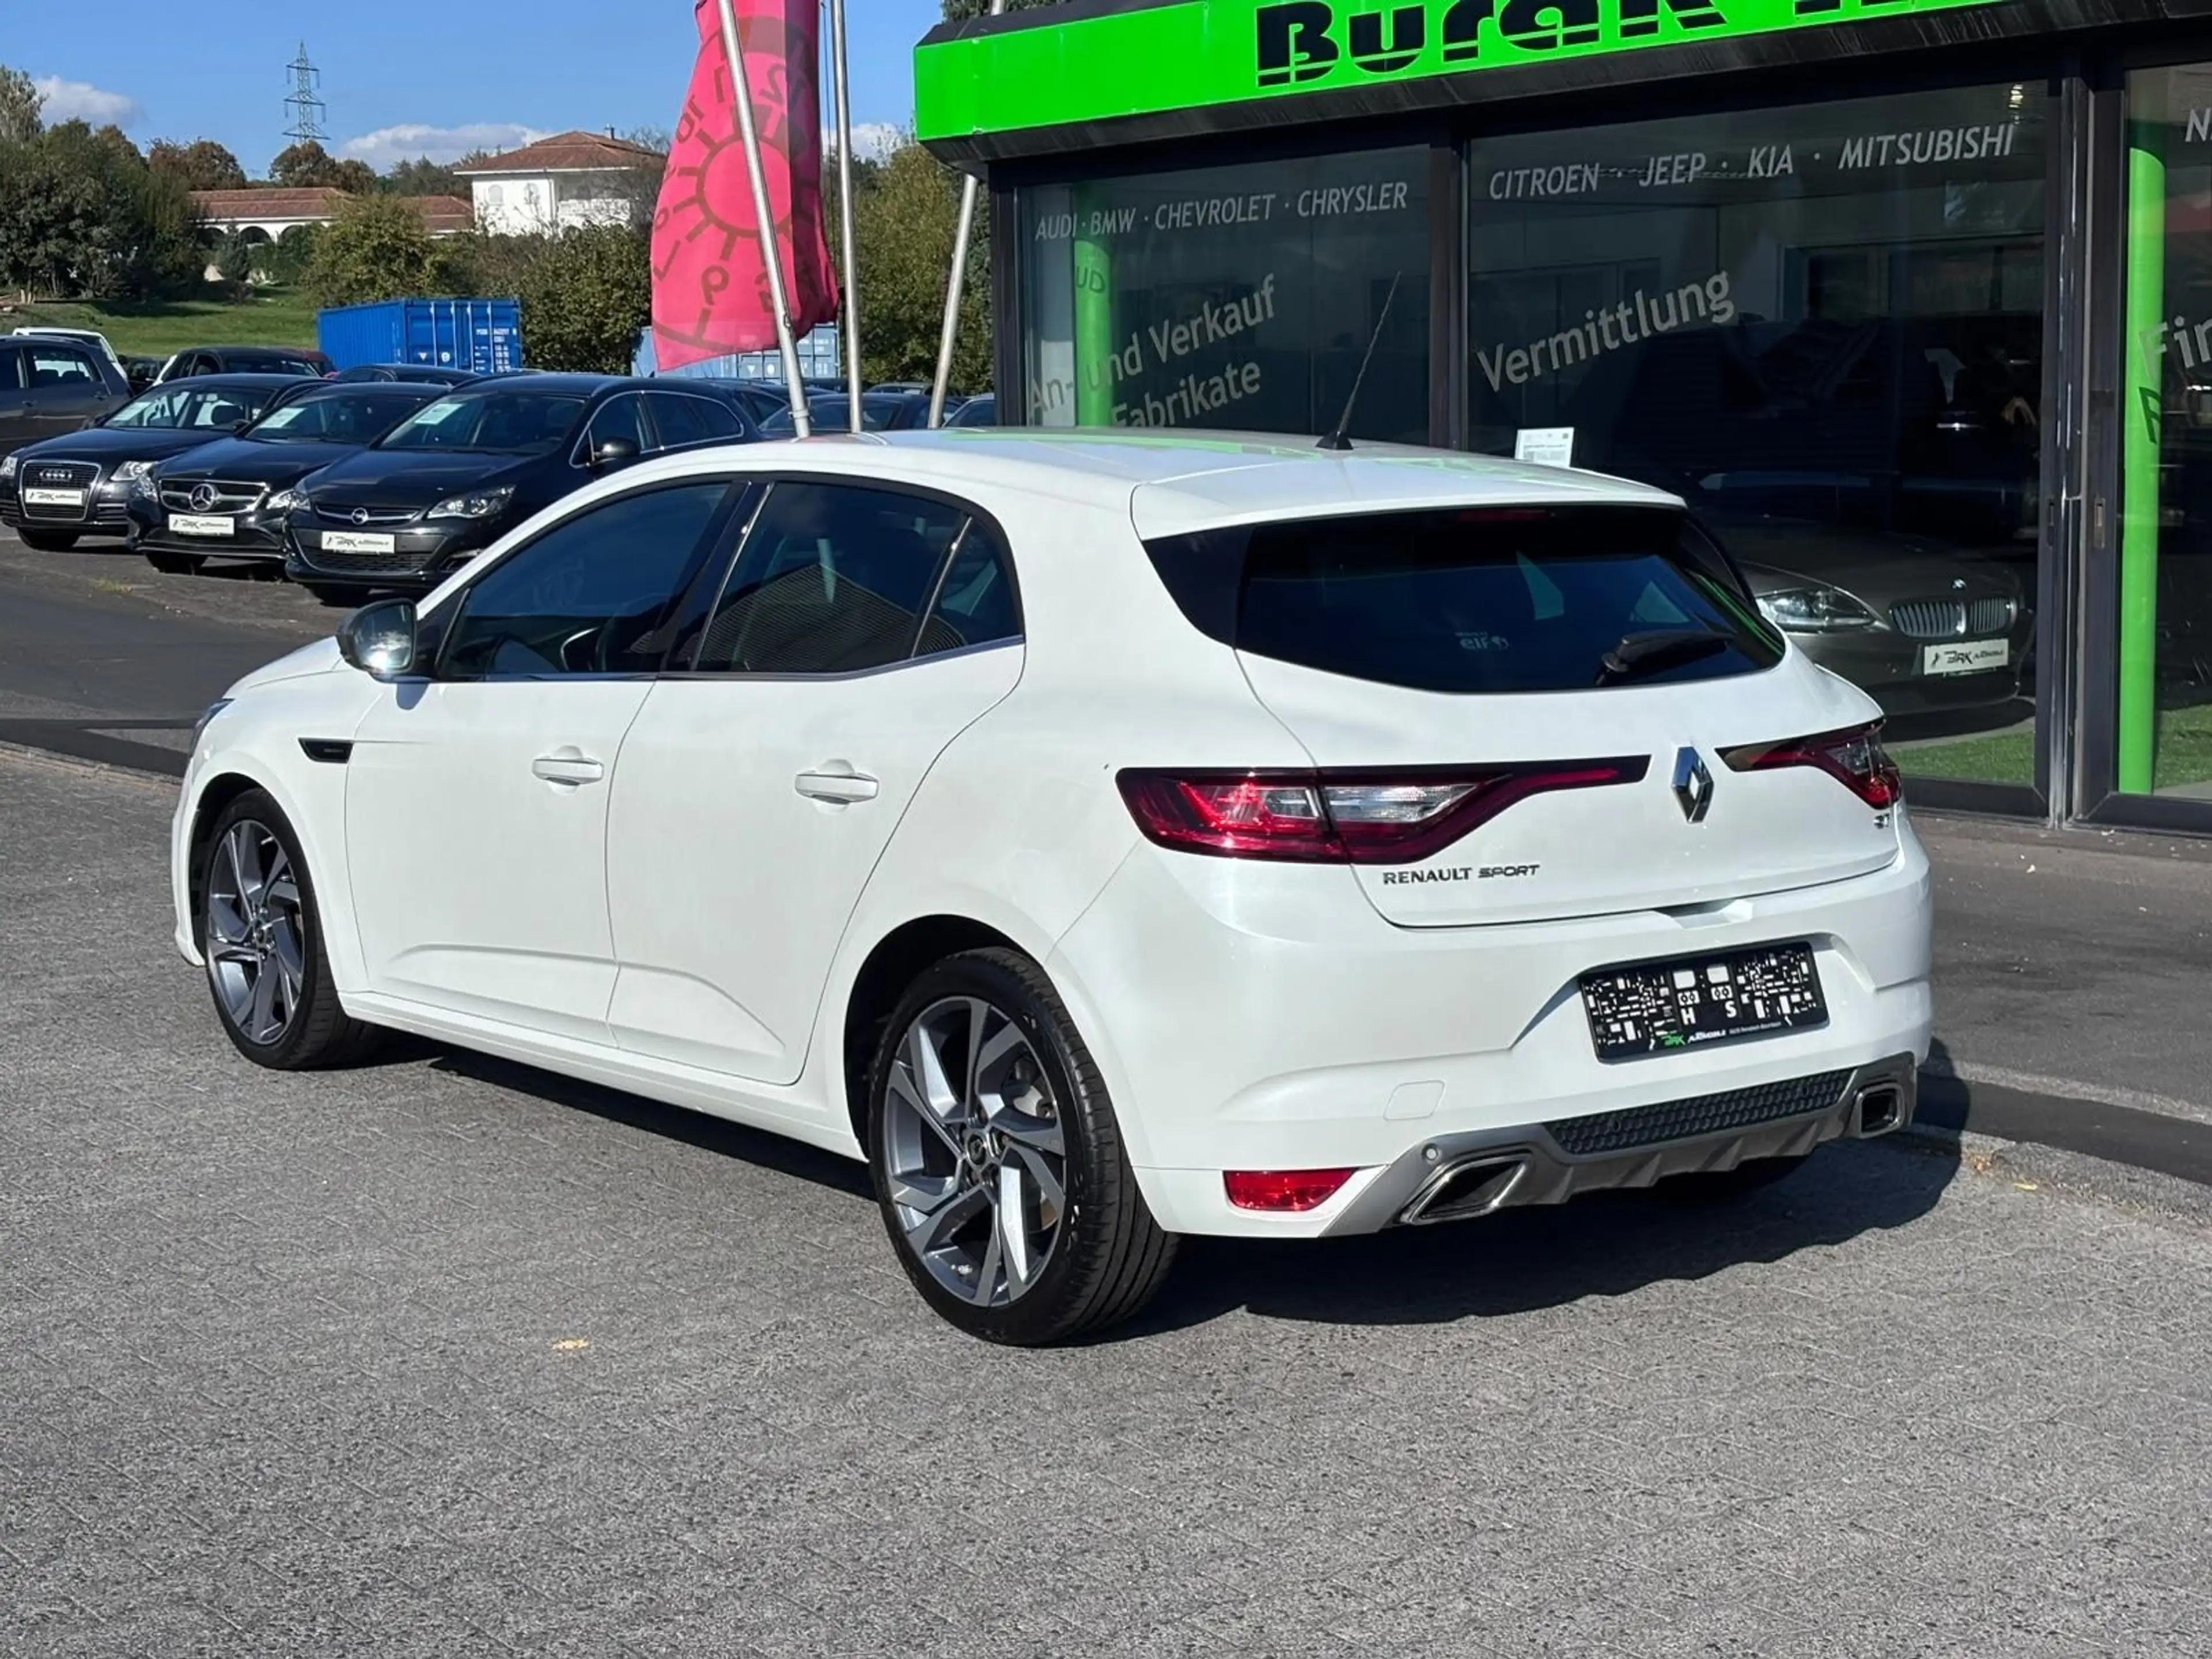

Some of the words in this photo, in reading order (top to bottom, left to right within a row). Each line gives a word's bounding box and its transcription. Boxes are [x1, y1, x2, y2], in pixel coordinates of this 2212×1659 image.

[1490, 162, 1600, 200] CITROEN
[1639, 153, 1706, 187] JEEP
[1747, 144, 1794, 177] KIA
[1838, 123, 2014, 170] MITSUBISHI
[1035, 212, 1078, 241] AUDI
[1090, 207, 1137, 236] BMW
[1155, 194, 1276, 230] CHEVROLET
[1297, 182, 1408, 217] CHRYSLER
[1148, 273, 1274, 364] Verkauf
[1476, 270, 1735, 393] Vermittlung
[1109, 361, 1262, 429] Fabrikate
[1384, 868, 1472, 885] RENAULT
[1478, 865, 1540, 878] SPORT
